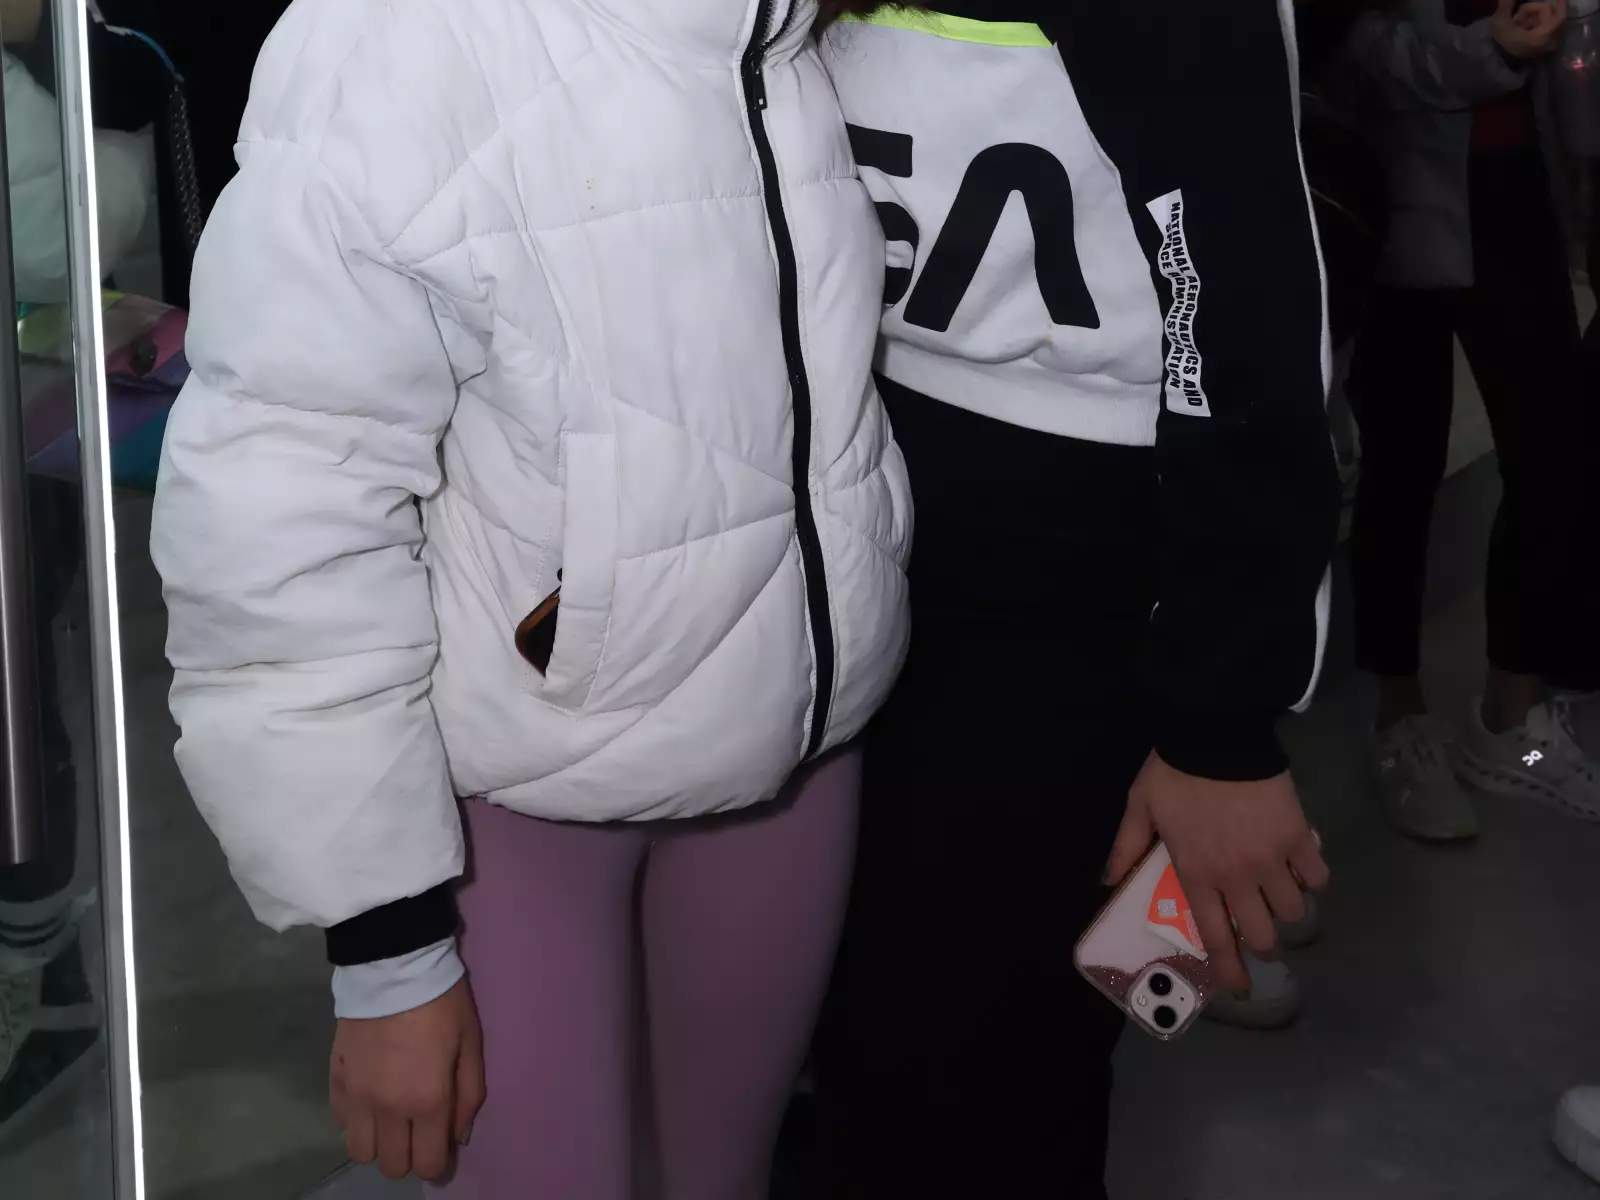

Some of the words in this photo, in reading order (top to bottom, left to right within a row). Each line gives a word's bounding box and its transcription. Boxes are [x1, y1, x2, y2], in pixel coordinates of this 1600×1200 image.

[1160, 223, 1173, 270] SPACE
[1170, 201, 1191, 273] NATIONAL
[1166, 272, 1186, 390] ADMINISTRATION
[1178, 275, 1198, 376] AERONAUTICS
[1182, 379, 1203, 407] AND
